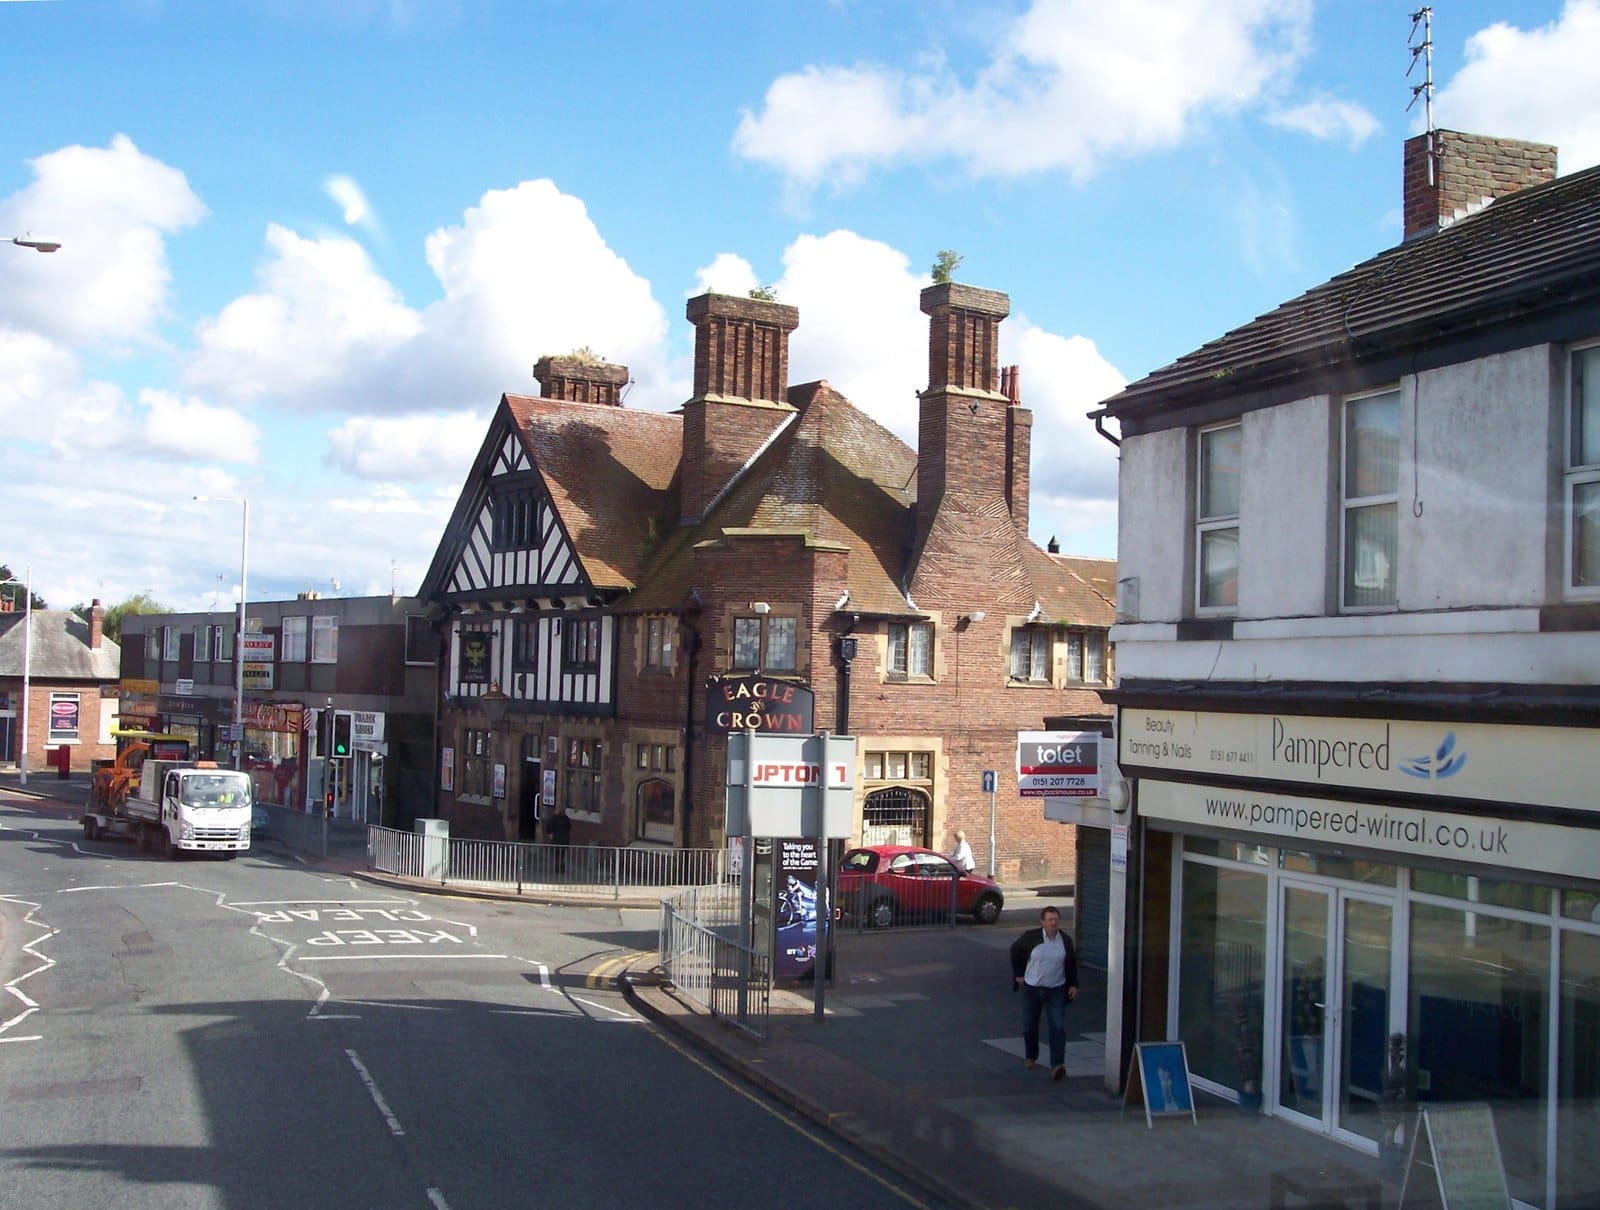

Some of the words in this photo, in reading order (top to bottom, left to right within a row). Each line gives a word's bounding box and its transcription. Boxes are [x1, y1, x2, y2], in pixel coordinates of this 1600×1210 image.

[723, 682, 795, 704] EAGLE
[717, 712, 803, 731] CROWN
[1145, 717, 1175, 735] Beauty
[1129, 739, 1160, 759] Tanning
[1162, 742, 1169, 757] &
[1171, 743, 1192, 759] Nails
[1210, 749, 1225, 761] 0151
[1272, 717, 1390, 778] Pampered
[1032, 778, 1048, 786] 0151
[1050, 778, 1065, 786] 207
[1066, 778, 1085, 786] 7728
[1206, 799, 1508, 854] www.pampered-wirral.co.uk
[782, 843, 801, 852] Taking
[802, 844, 814, 852] you
[782, 858, 790, 866] of
[254, 908, 433, 923] CLEAR
[306, 929, 464, 946] KEEP
